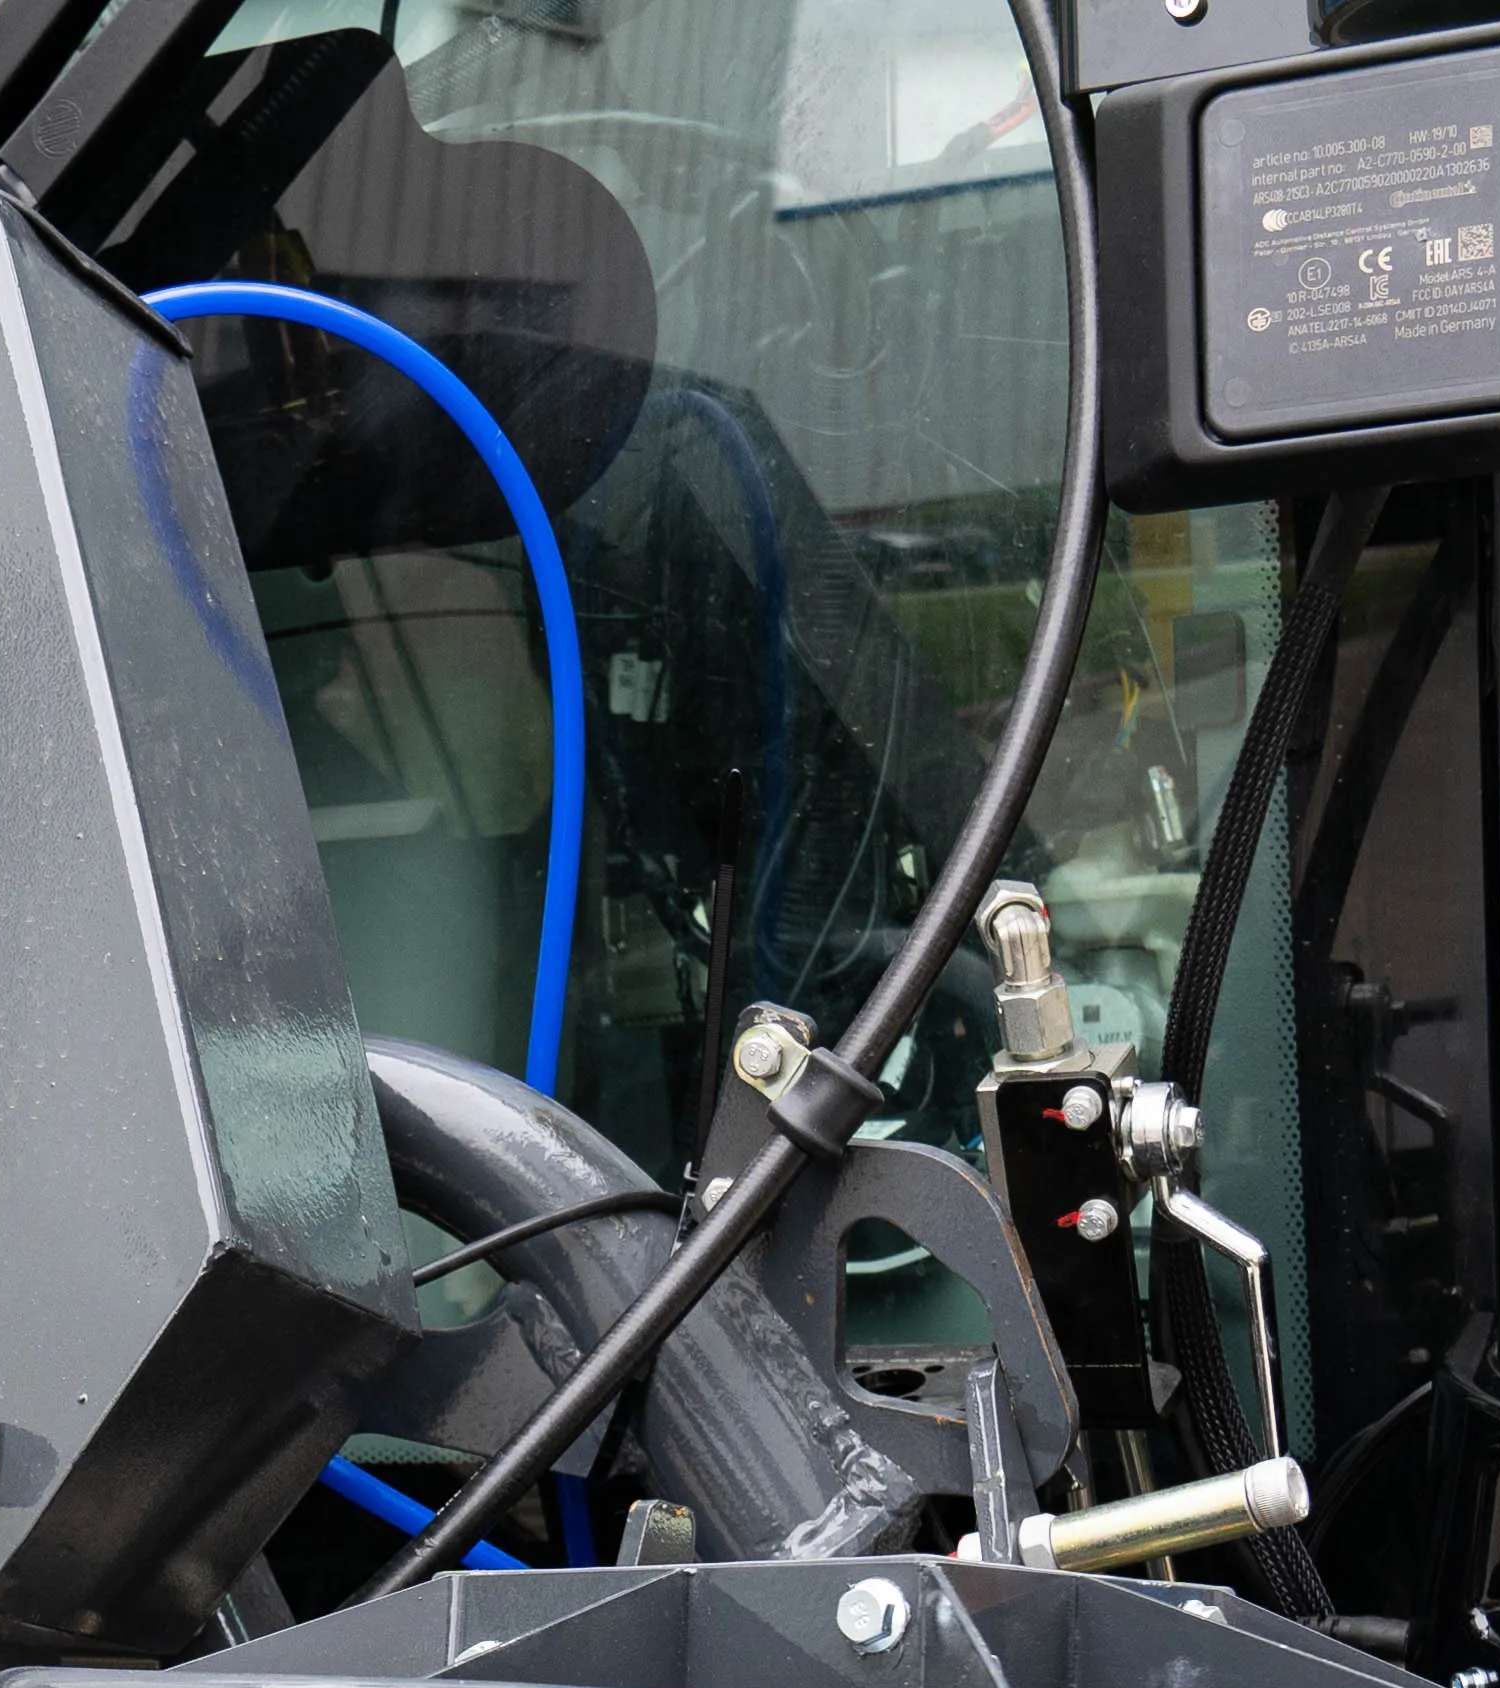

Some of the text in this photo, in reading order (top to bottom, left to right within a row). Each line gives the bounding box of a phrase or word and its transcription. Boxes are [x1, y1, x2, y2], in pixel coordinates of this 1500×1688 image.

[1251, 168, 1297, 186] internal
[1300, 164, 1325, 182] part
[1357, 142, 1467, 170] A2-C770-0590-2-00
[1253, 151, 1290, 169] article
[1312, 135, 1386, 159] 10.005.300-08
[1359, 246, 1393, 274] CE
[1395, 316, 1497, 340] Made in Germany
